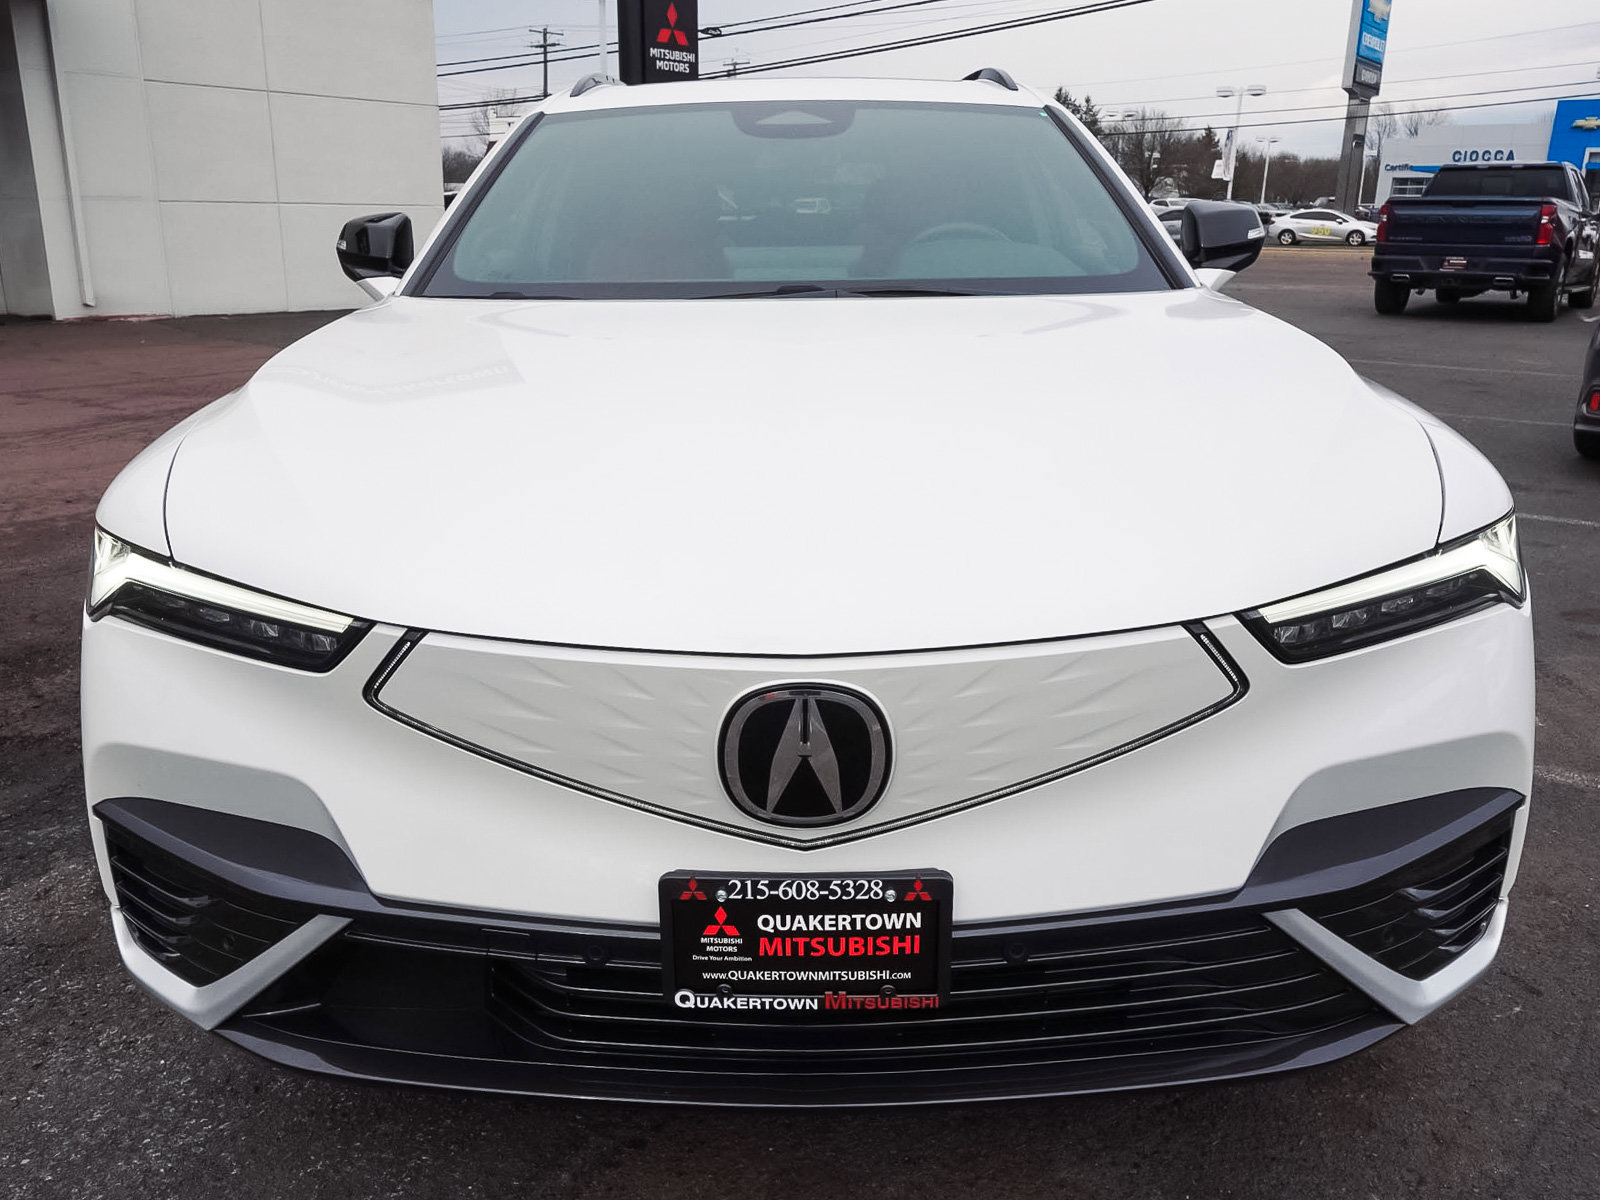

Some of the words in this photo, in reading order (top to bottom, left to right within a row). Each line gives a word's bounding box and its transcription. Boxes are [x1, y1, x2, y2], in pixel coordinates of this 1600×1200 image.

[650, 47, 695, 63] MITSUBISHI
[656, 60, 690, 73] MOTORS
[1452, 150, 1515, 163] CIOCCA
[727, 879, 884, 901] 215-608-5328
[757, 912, 922, 933] QUAKERTOWN
[700, 937, 743, 945] MITSUBISHI
[706, 945, 738, 953] MOTORS
[759, 935, 920, 957] MITSUBISHI
[674, 990, 818, 1010] QUAKERTOWN
[824, 991, 940, 1010] MITSUBISHI
